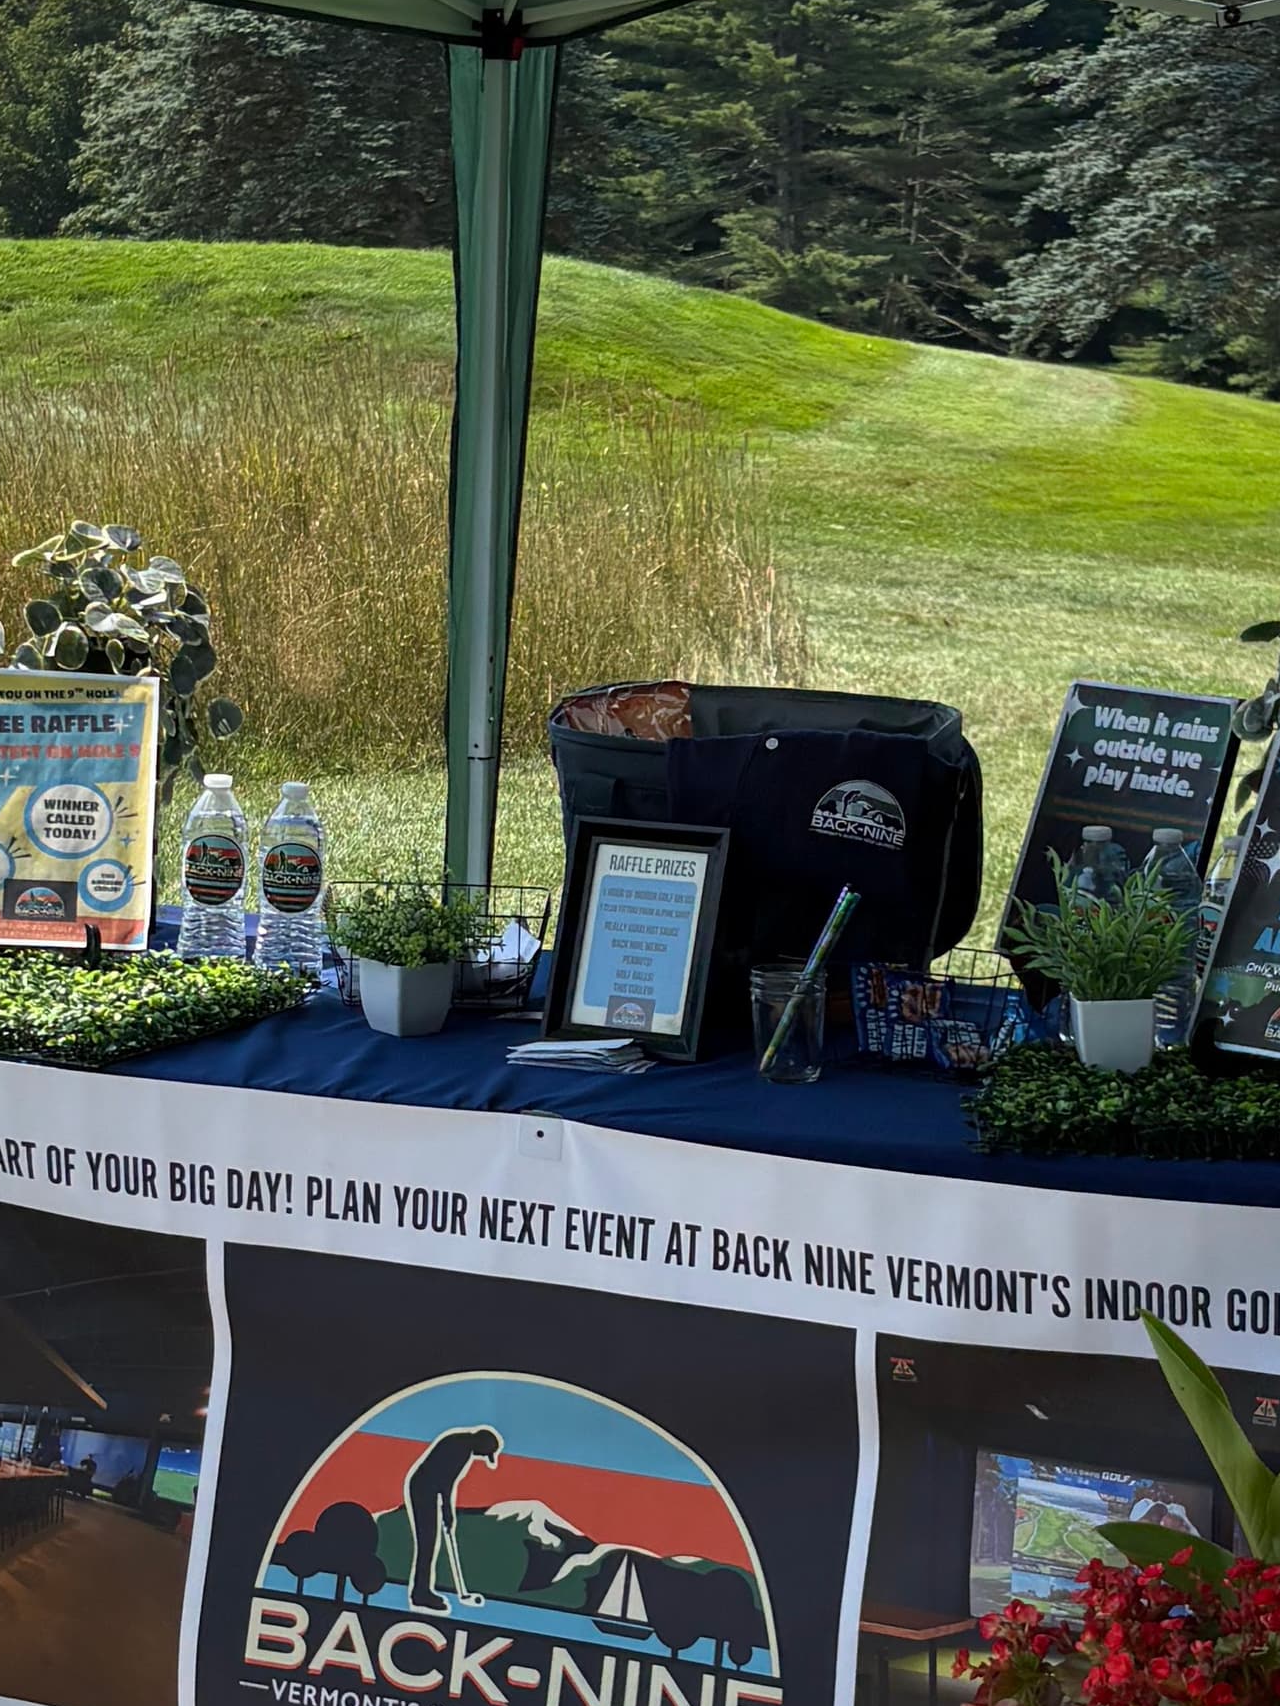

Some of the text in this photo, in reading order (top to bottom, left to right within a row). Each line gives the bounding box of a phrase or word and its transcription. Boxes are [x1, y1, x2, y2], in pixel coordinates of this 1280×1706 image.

[0, 689, 22, 700] YOU
[44, 689, 65, 700] THE
[31, 715, 116, 734] RAFFLE
[1094, 705, 1220, 743] When it rains
[1093, 738, 1202, 770] outside we
[1083, 762, 1195, 798] play inside.
[44, 798, 100, 813] WINNER
[46, 813, 95, 826] CALLED
[44, 827, 97, 840] TODAY!
[810, 815, 905, 846] BACK-NINE
[609, 854, 697, 877] RAFFLE PRIZES
[1245, 962, 1272, 977] Only
[46, 1144, 77, 1188] OF
[86, 1150, 158, 1199] YOUR
[169, 1161, 216, 1207] BIG
[226, 1169, 293, 1215] DAY!
[306, 1175, 382, 1225] PLAN
[393, 1185, 467, 1237] YOUR
[479, 1196, 556, 1248] NEXT
[565, 1206, 656, 1263] EVENT
[664, 1220, 703, 1269] AT
[713, 1228, 791, 1282] BACK
[804, 1243, 876, 1295] NINE
[886, 1255, 1071, 1320] VERMONT'S
[1084, 1277, 1211, 1329] INDOOR
